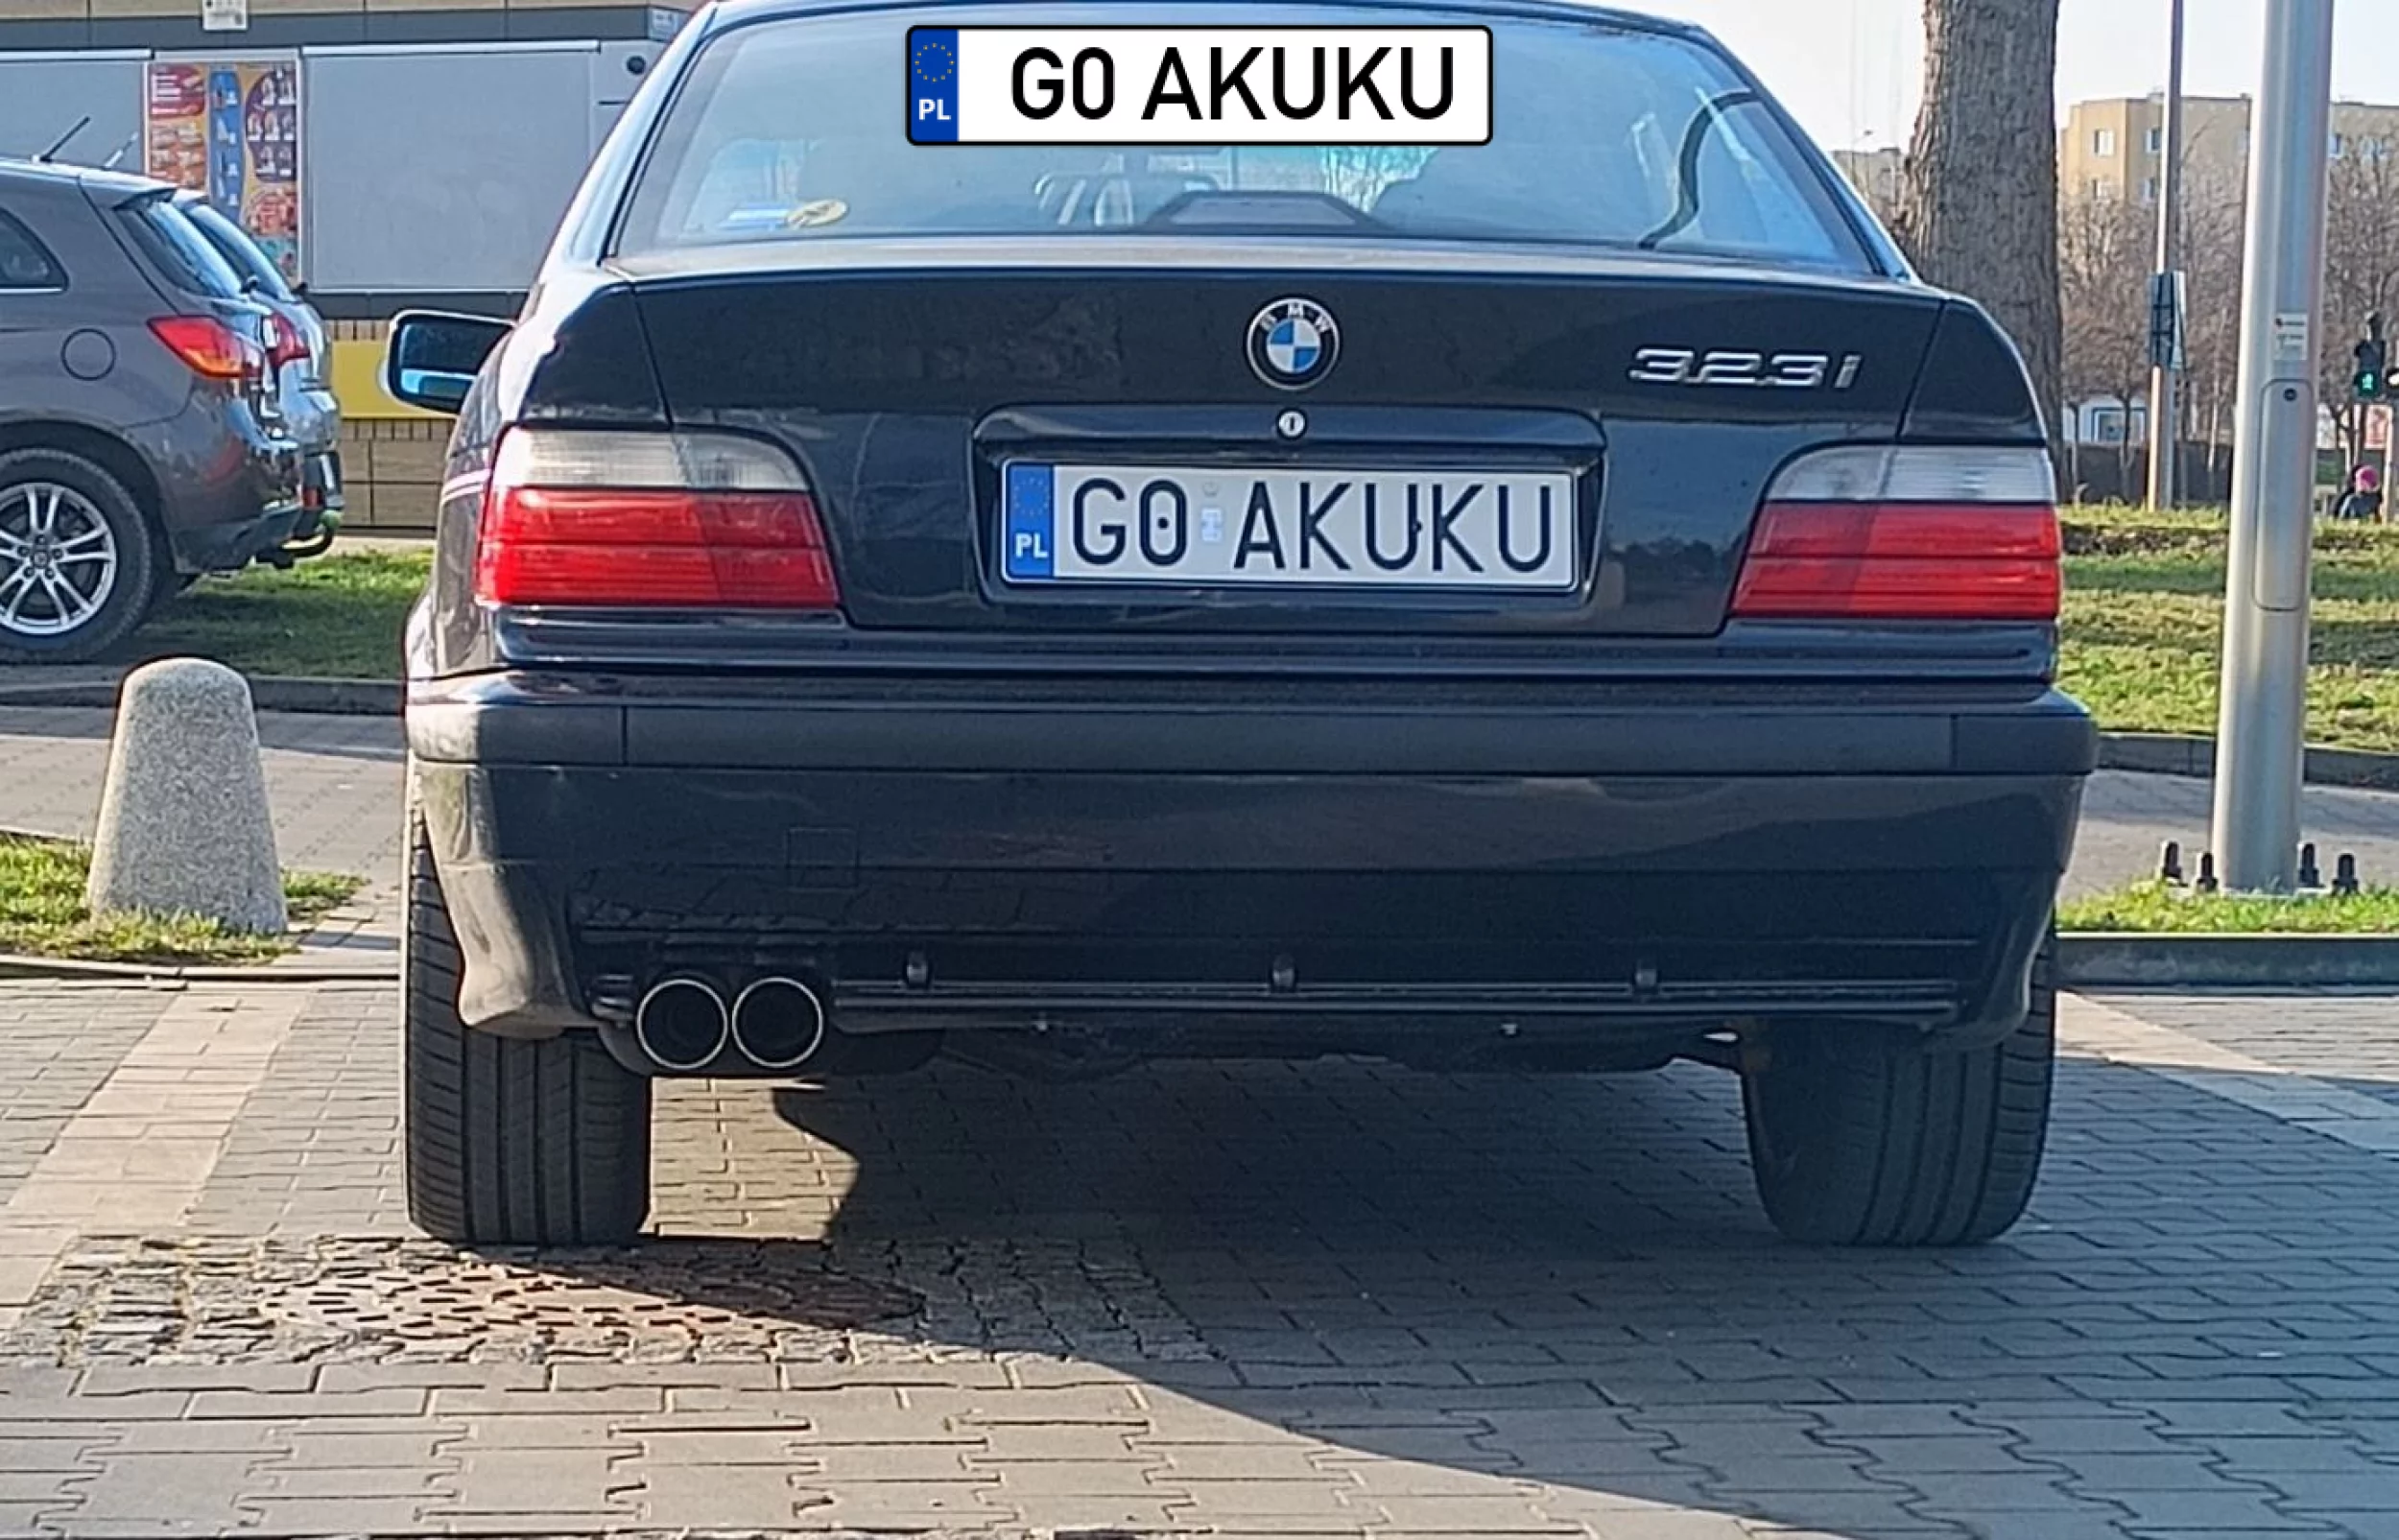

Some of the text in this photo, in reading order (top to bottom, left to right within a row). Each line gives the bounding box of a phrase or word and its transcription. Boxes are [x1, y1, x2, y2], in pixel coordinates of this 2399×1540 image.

[1260, 302, 1331, 333] BMW
[1629, 348, 1862, 388] 323i
[1233, 482, 1552, 572] AKUKU
[1015, 533, 1048, 558] PL
